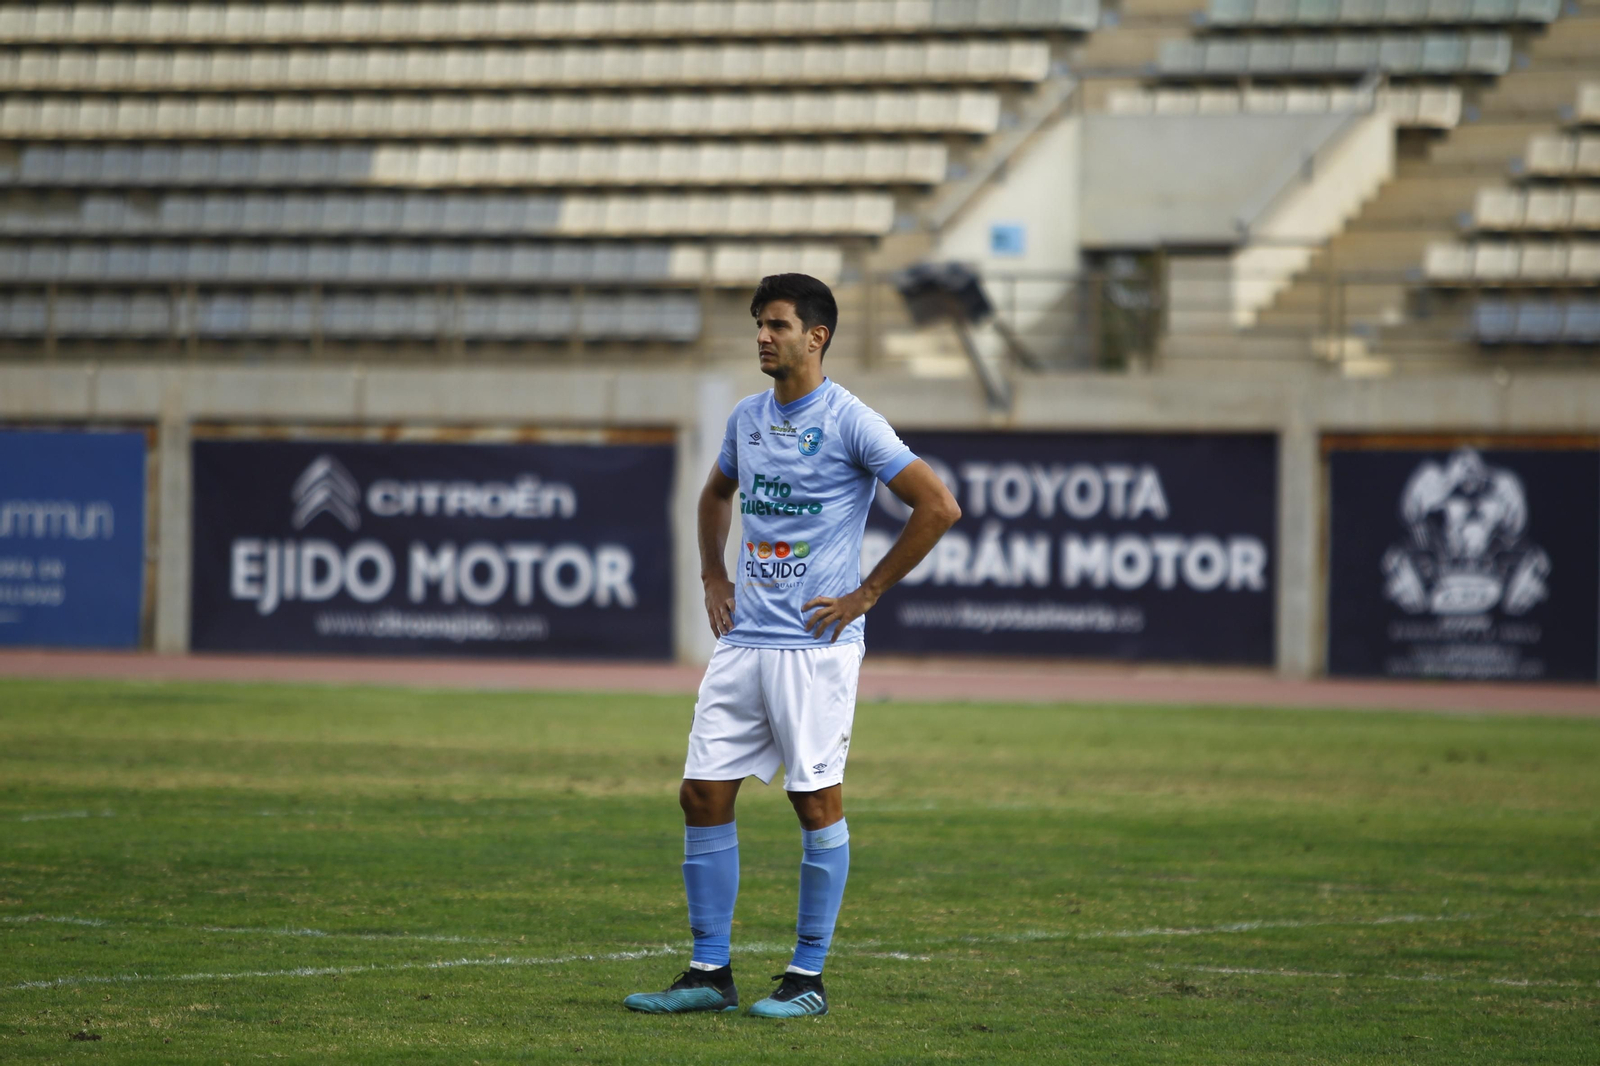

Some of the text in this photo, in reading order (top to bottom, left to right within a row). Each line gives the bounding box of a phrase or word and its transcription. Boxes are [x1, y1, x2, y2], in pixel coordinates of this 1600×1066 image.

[752, 474, 792, 498] Frío
[963, 465, 1167, 519] TOYOTA
[231, 540, 635, 614] EJIDO MOTOR
[760, 562, 807, 578] EJIDO
[1063, 536, 1267, 591] MOTOR
